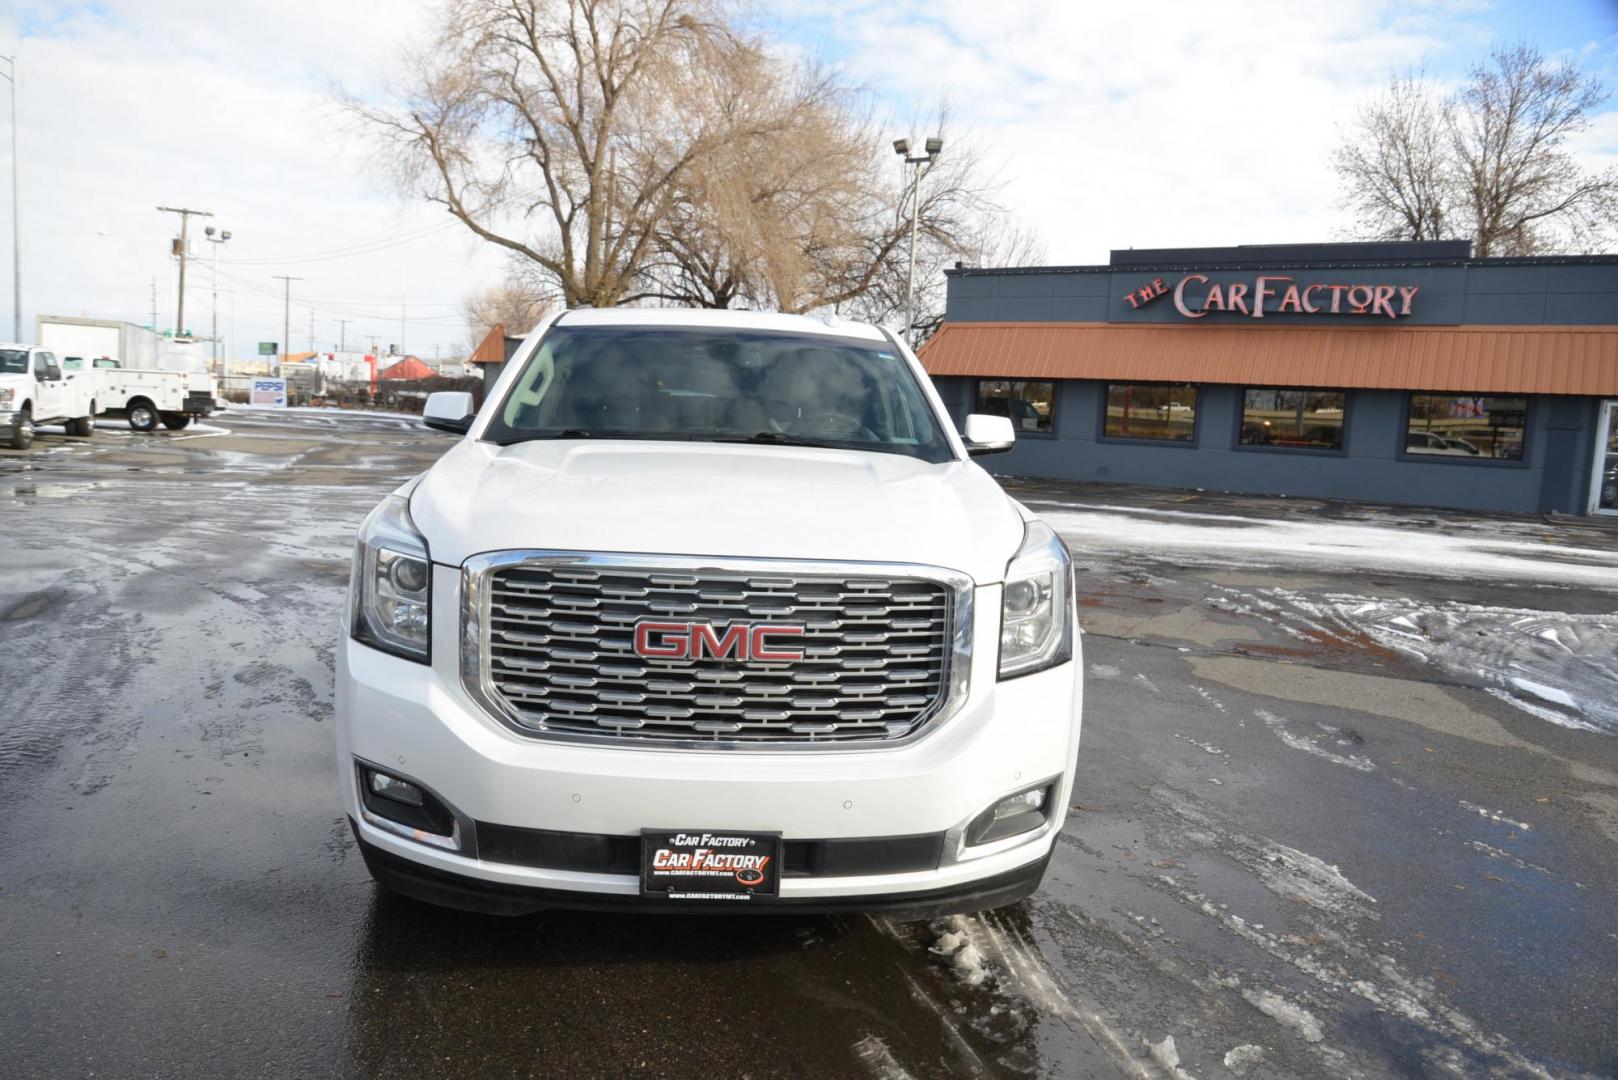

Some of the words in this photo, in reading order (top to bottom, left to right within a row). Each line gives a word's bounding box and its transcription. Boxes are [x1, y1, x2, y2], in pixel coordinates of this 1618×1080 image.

[1124, 276, 1170, 309] THE
[634, 621, 805, 662] GMC
[675, 834, 699, 846] CAR
[700, 834, 749, 847] FACTORY
[653, 849, 691, 868] CAR
[691, 849, 768, 870] FACTORY
